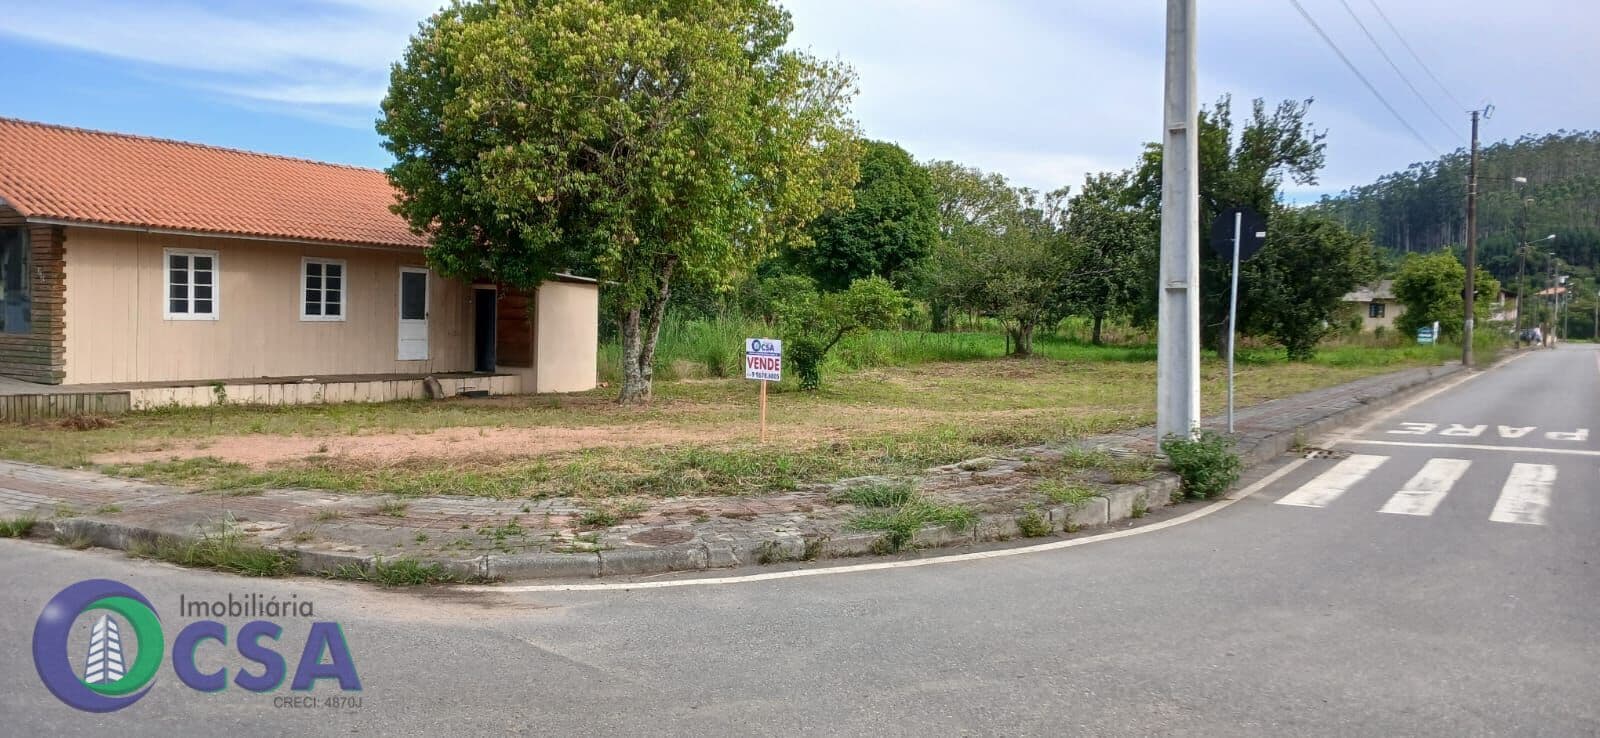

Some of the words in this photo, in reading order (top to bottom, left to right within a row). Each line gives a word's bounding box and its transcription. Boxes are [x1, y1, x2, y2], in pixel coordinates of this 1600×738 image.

[761, 344, 775, 352] CSA
[747, 356, 780, 371] VENDE
[1385, 422, 1590, 441] PARE
